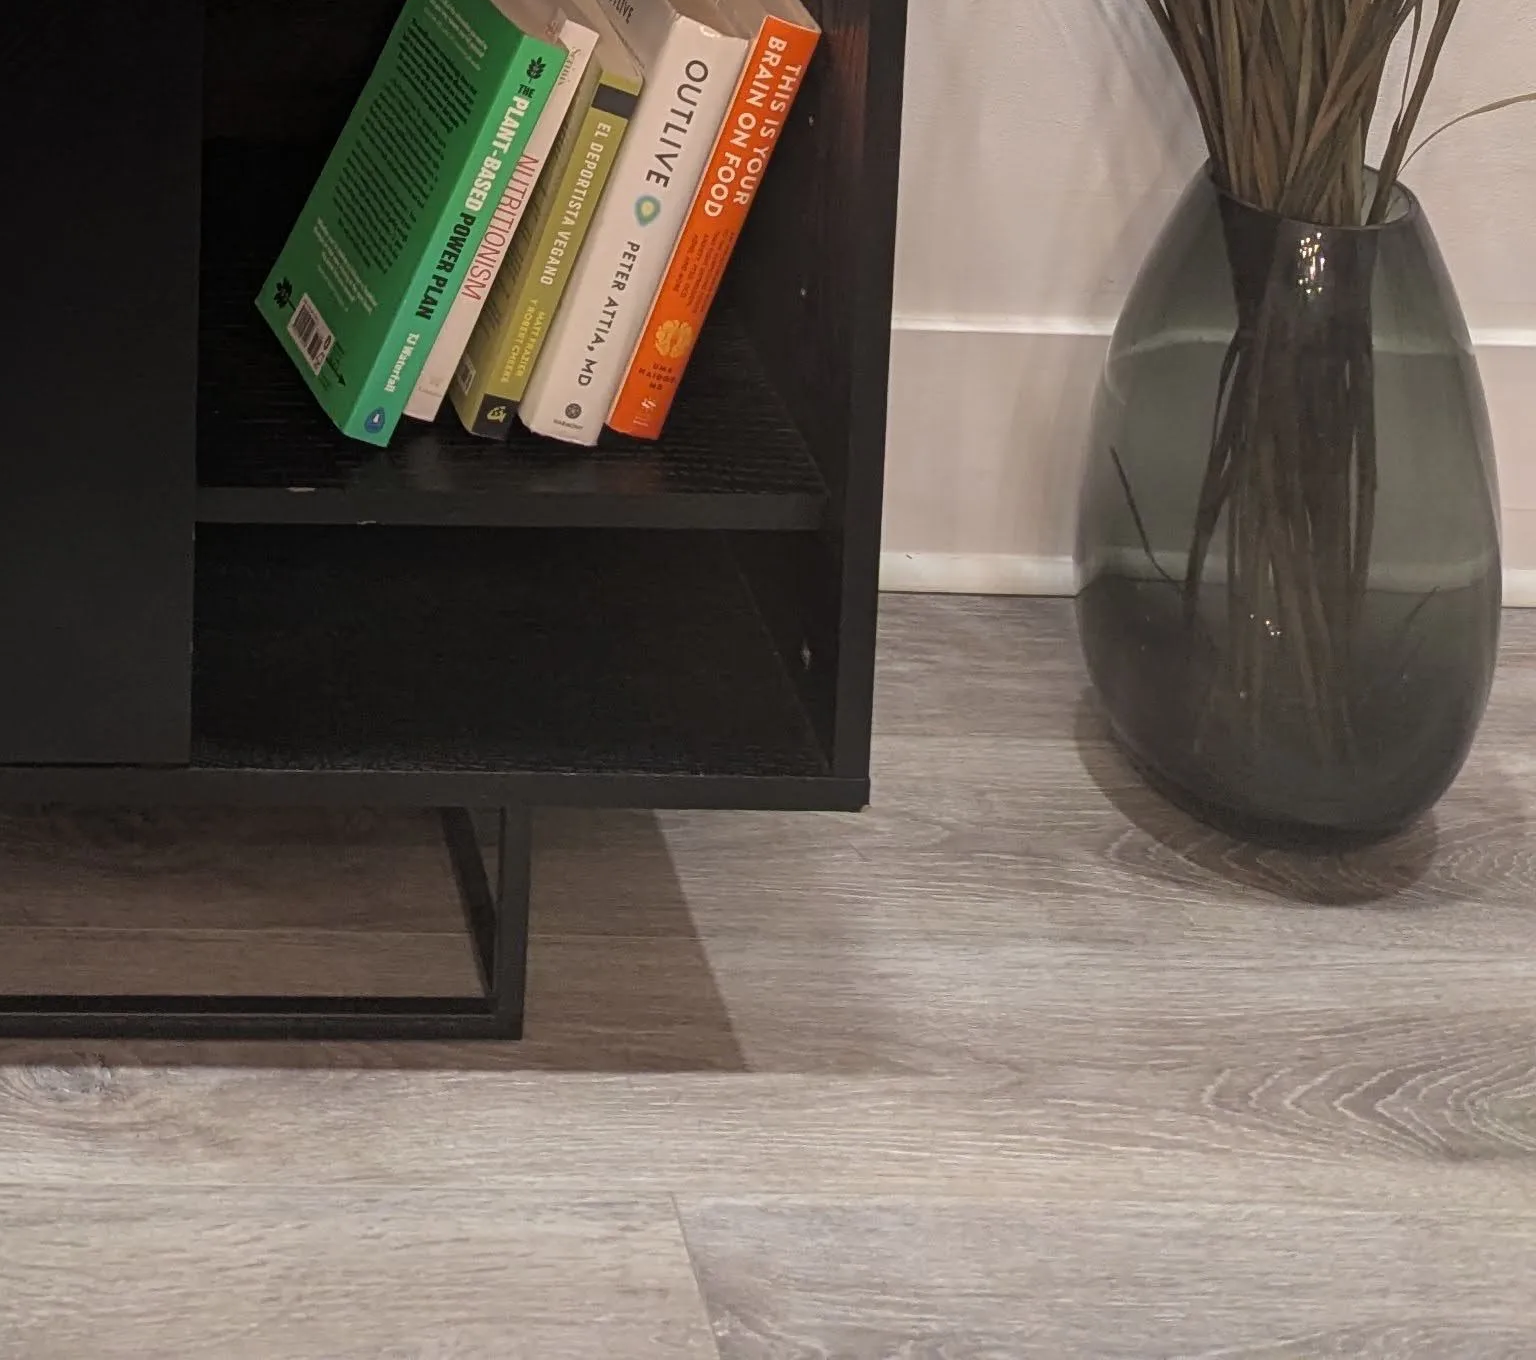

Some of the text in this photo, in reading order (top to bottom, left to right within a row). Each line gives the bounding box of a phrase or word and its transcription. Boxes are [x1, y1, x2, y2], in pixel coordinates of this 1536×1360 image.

[645, 60, 709, 188] OUTLIVE
[730, 112, 756, 148] ON
[733, 65, 802, 205] THIS IS YOUR
[746, 36, 787, 108] BRAIN
[416, 84, 535, 320] THE PLANT-BASED POWER PLAN
[462, 155, 539, 300] NUTRITIONISM
[540, 121, 611, 285] EL DEPORTISTA VEGANO
[704, 152, 742, 217] FOOD
[384, 332, 420, 392] TJ Waterfall
[578, 240, 641, 386] PETER ATTIA, MD
